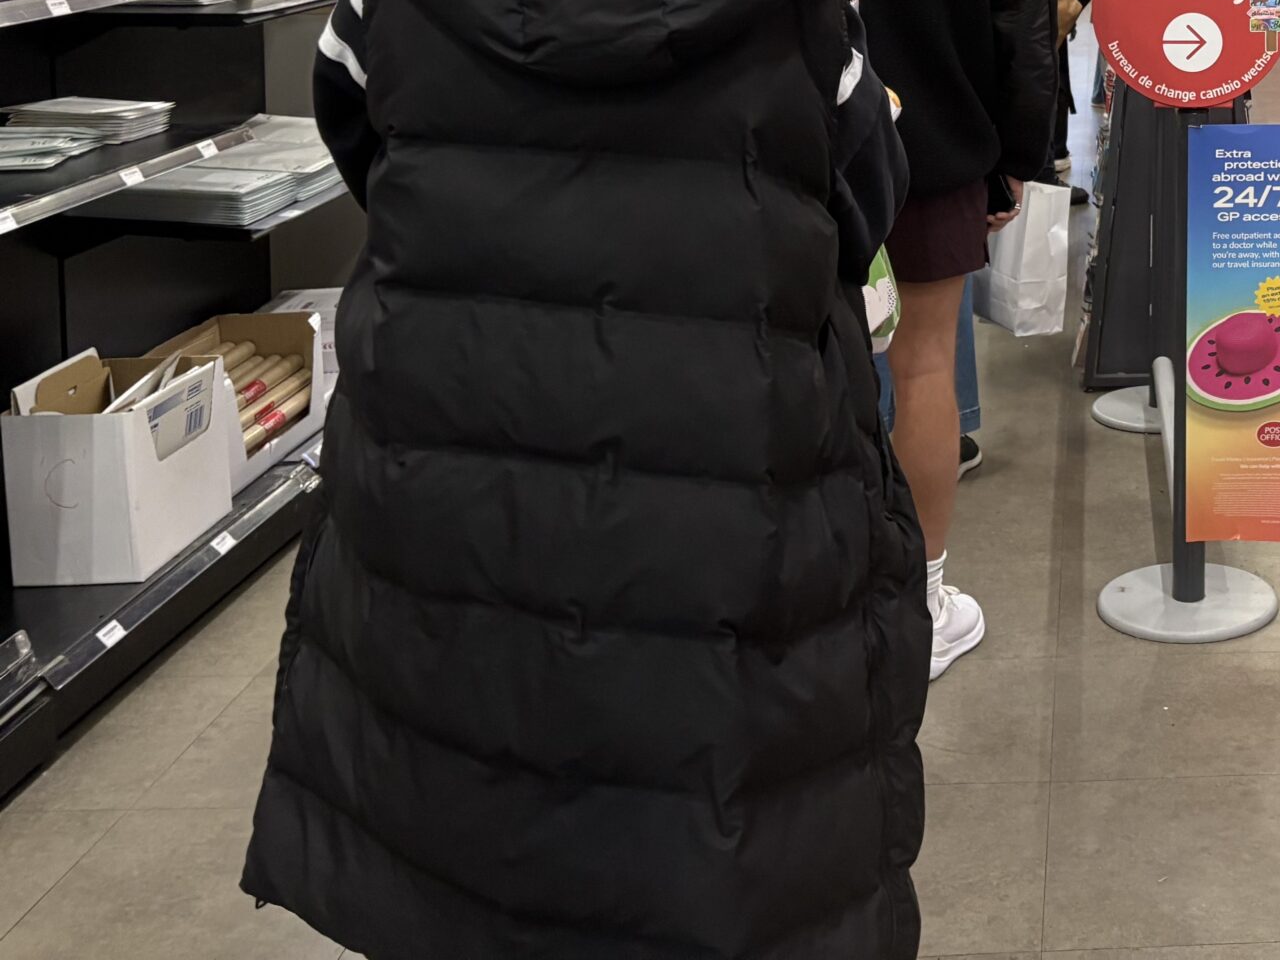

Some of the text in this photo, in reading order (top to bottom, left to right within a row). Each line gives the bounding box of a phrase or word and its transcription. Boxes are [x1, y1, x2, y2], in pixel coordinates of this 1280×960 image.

[1108, 40, 1273, 103] bureau de change cambio wechs
[1215, 149, 1251, 159] Extra
[1212, 171, 1264, 182] abroad
[1217, 211, 1240, 222] GP
[1212, 232, 1230, 240] Free
[1231, 231, 1272, 243] outpatient
[1229, 241, 1255, 249] doctor
[1256, 241, 1278, 249] while
[1212, 250, 1280, 260] you're away, with
[1227, 260, 1250, 268] travel
